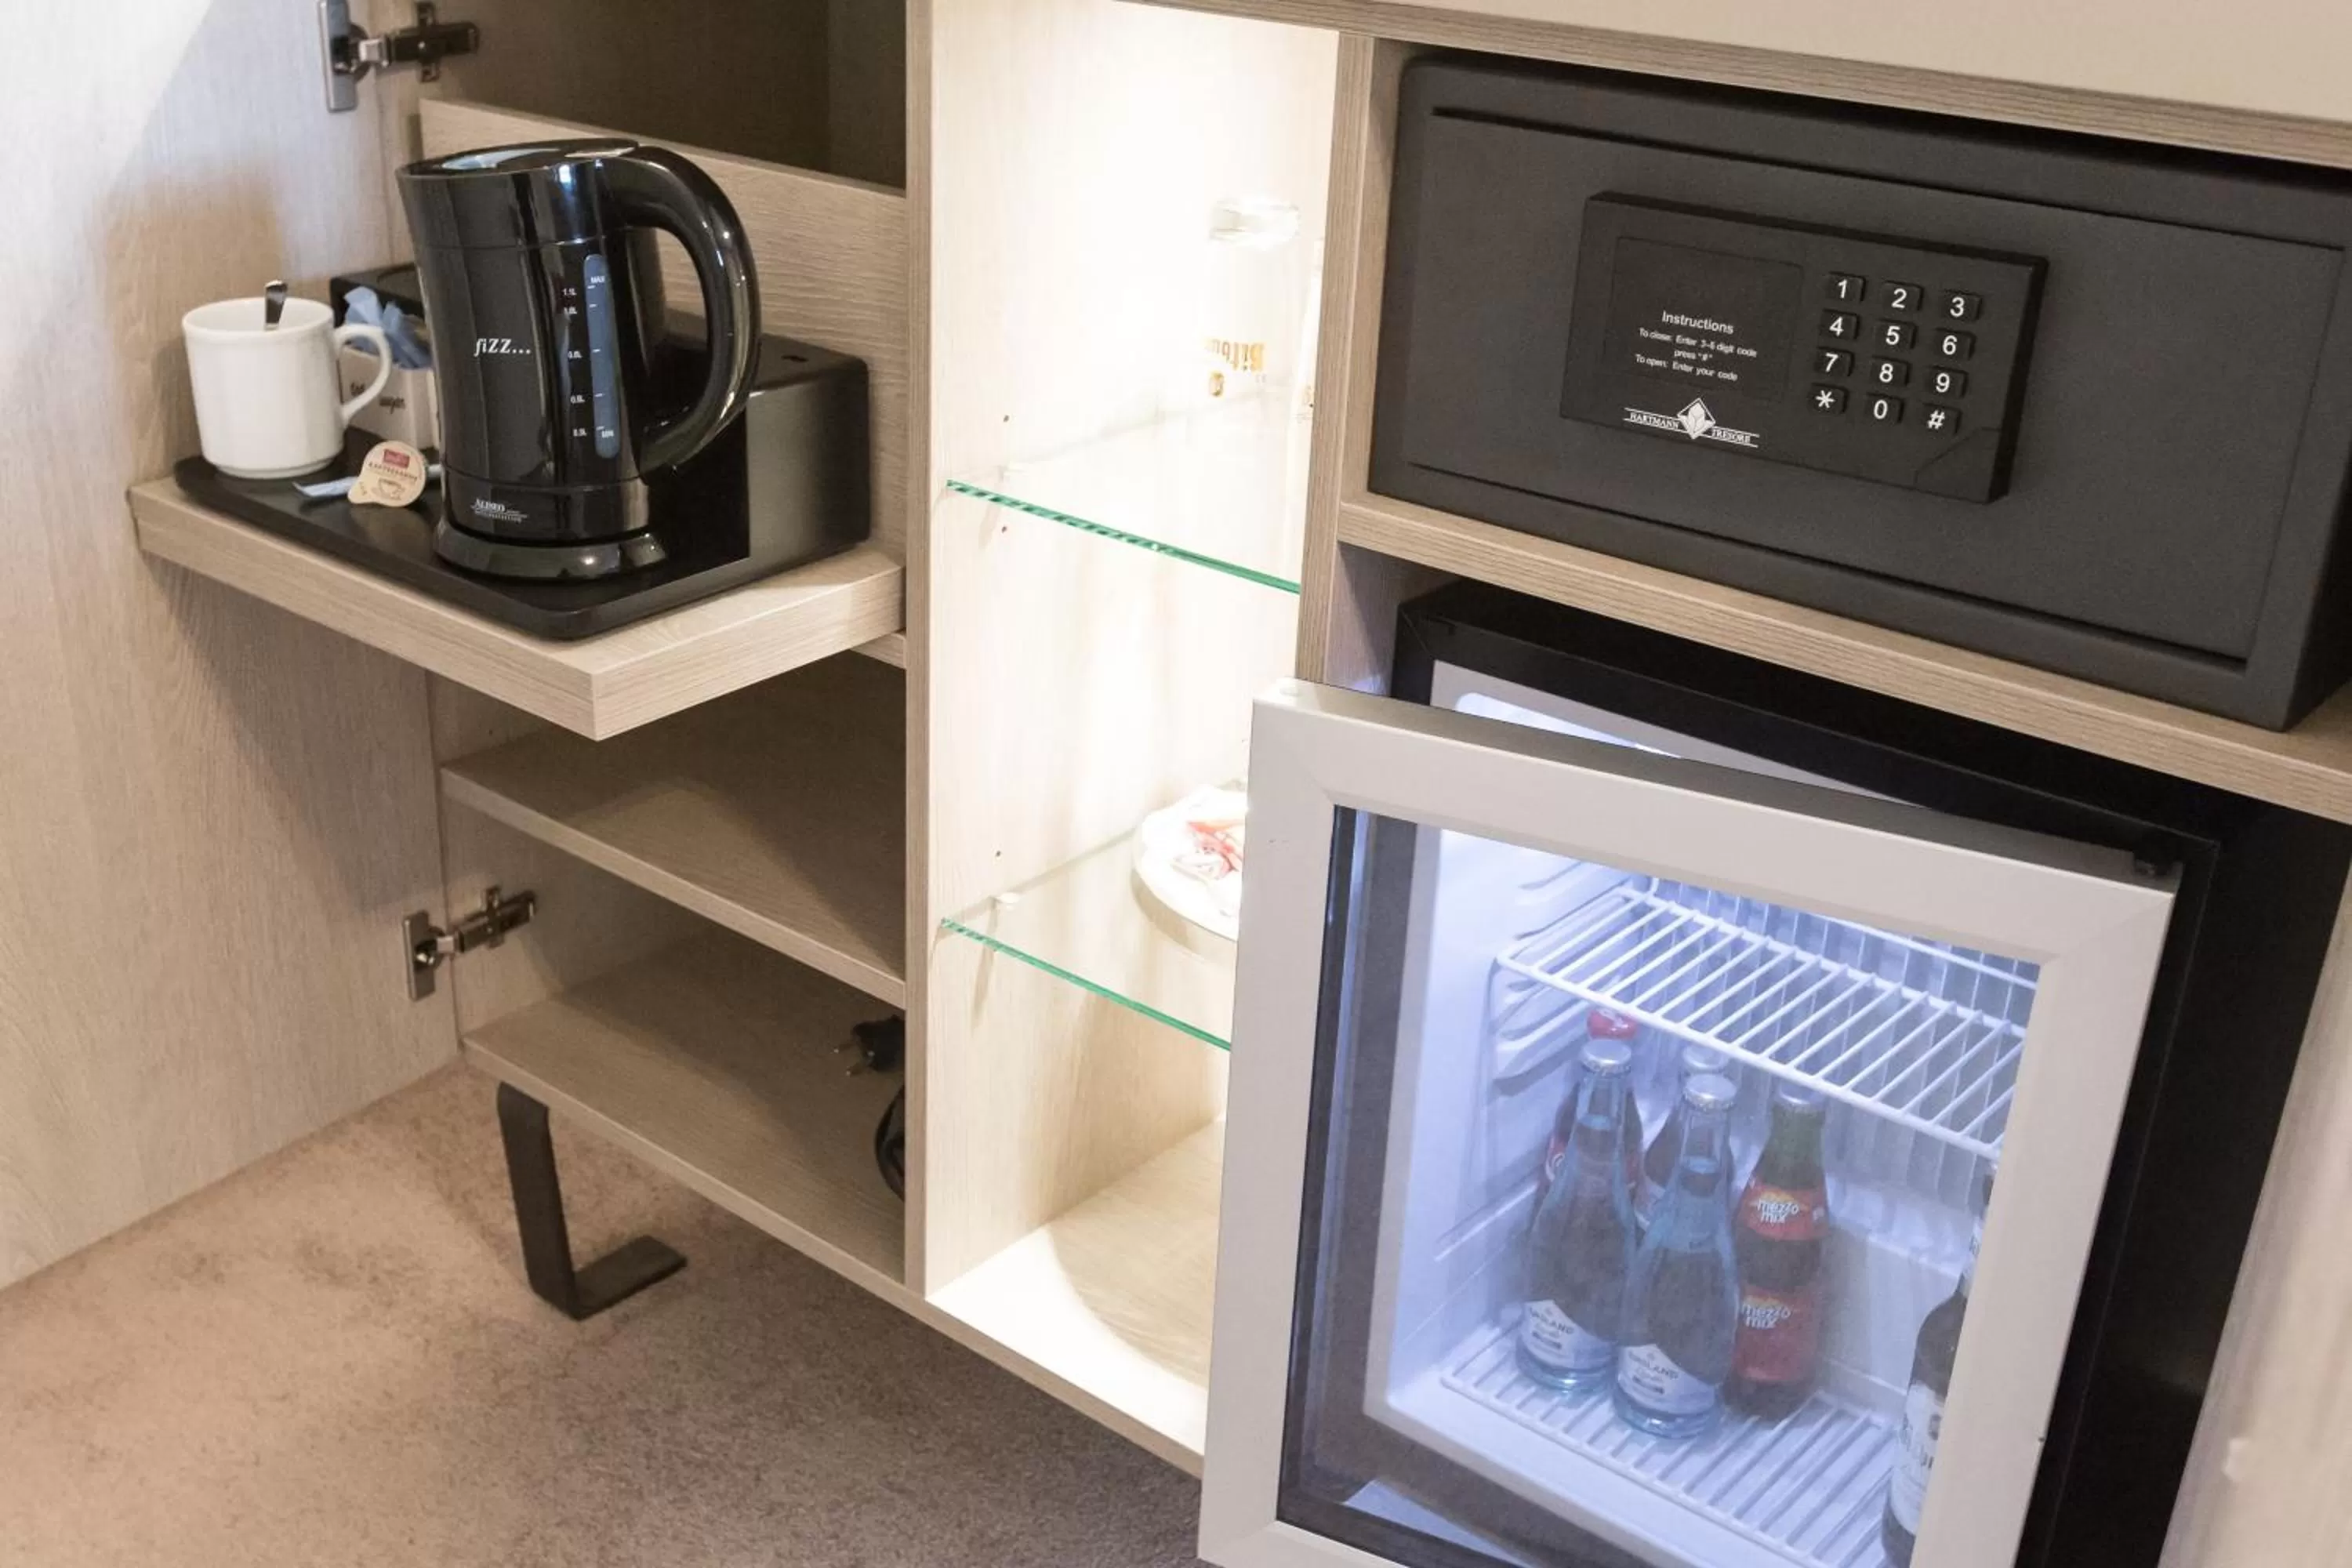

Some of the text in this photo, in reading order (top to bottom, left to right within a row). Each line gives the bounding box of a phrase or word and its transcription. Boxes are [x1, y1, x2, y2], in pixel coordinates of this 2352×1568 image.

[1838, 279, 1965, 318] 1 2 3
[1661, 310, 1734, 335] Instructions
[1829, 317, 1958, 355] 4 5 6
[1737, 347, 1758, 358] code
[1695, 366, 1715, 376] your
[1717, 370, 1738, 382] code
[1825, 352, 1950, 393] 7 8 9
[1630, 412, 1679, 430] HARTMANN
[1873, 399, 1888, 419] 0
[1928, 409, 1945, 430] #
